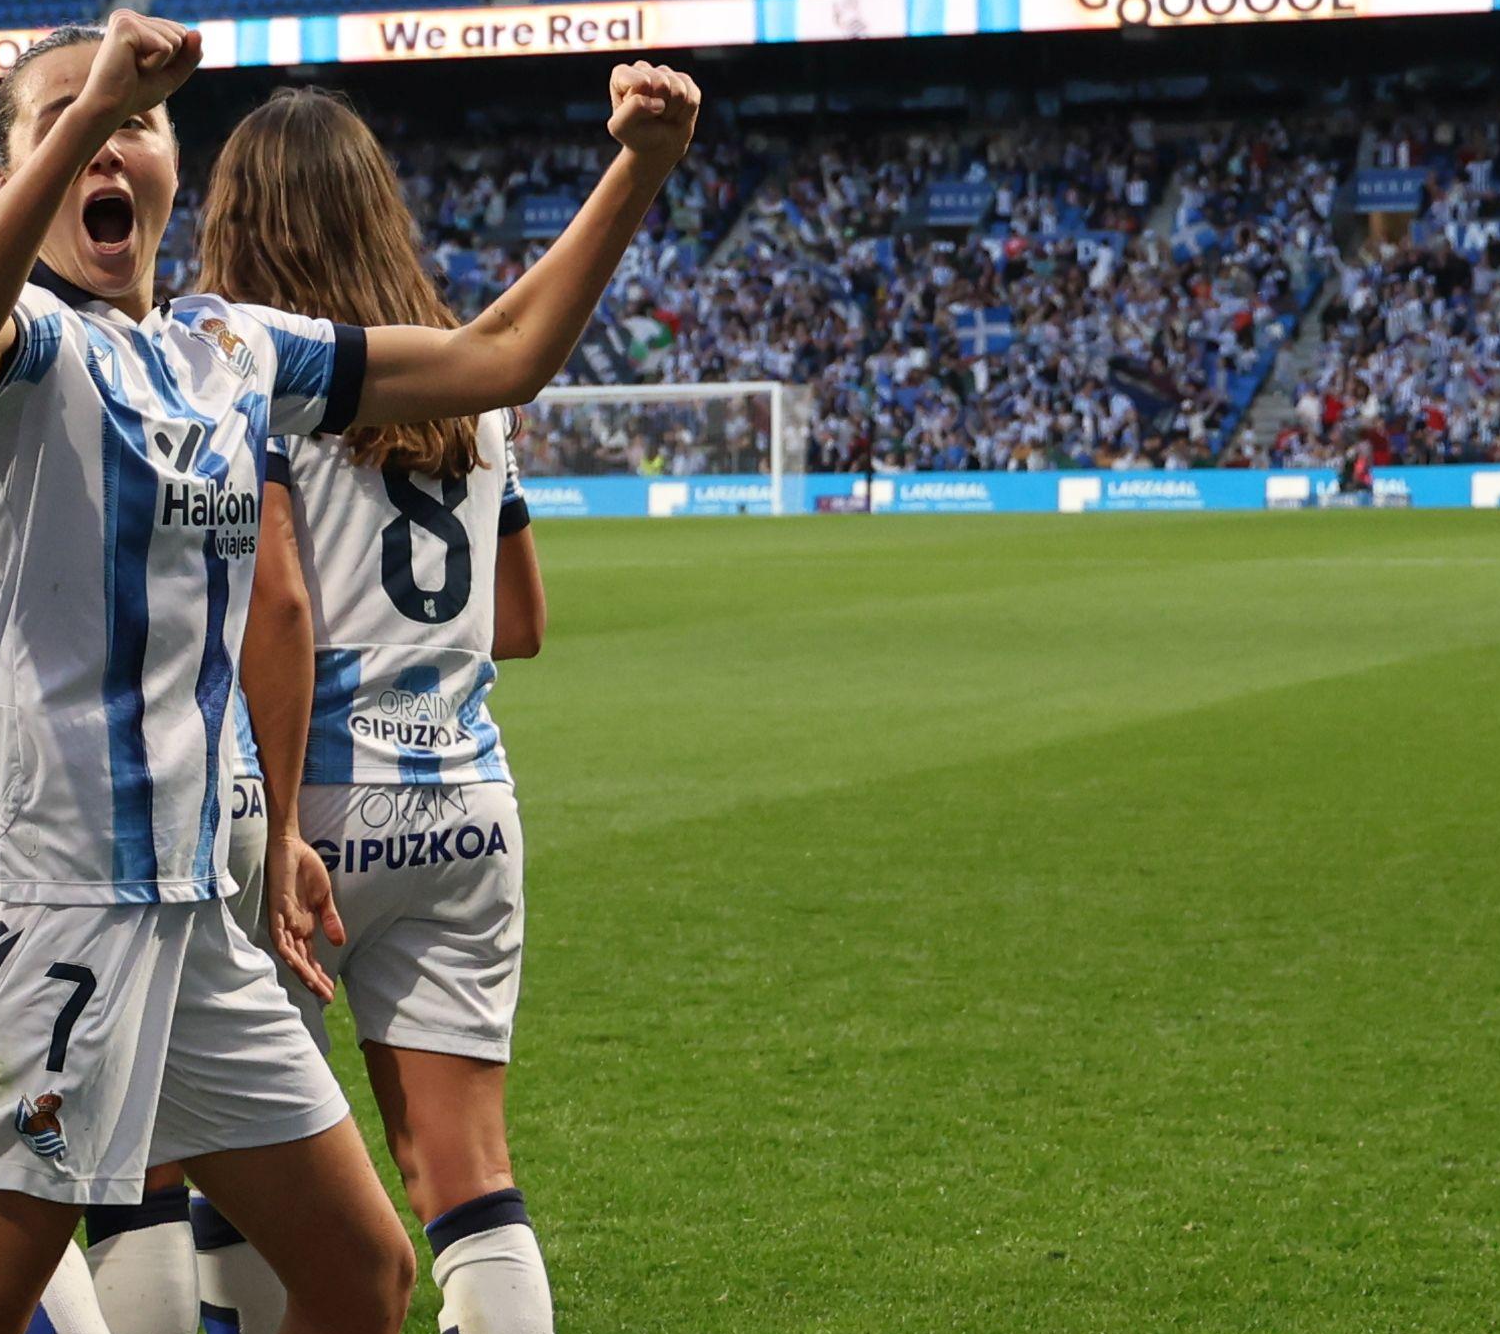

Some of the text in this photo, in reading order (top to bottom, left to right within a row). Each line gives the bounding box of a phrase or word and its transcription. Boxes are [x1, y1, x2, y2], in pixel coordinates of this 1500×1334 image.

[379, 8, 645, 52] We are Real
[162, 482, 255, 526] Halcón
[217, 531, 255, 560] viajes
[381, 468, 474, 624] 8
[310, 821, 509, 874] GIPUZKOA
[46, 962, 97, 1072] 7
